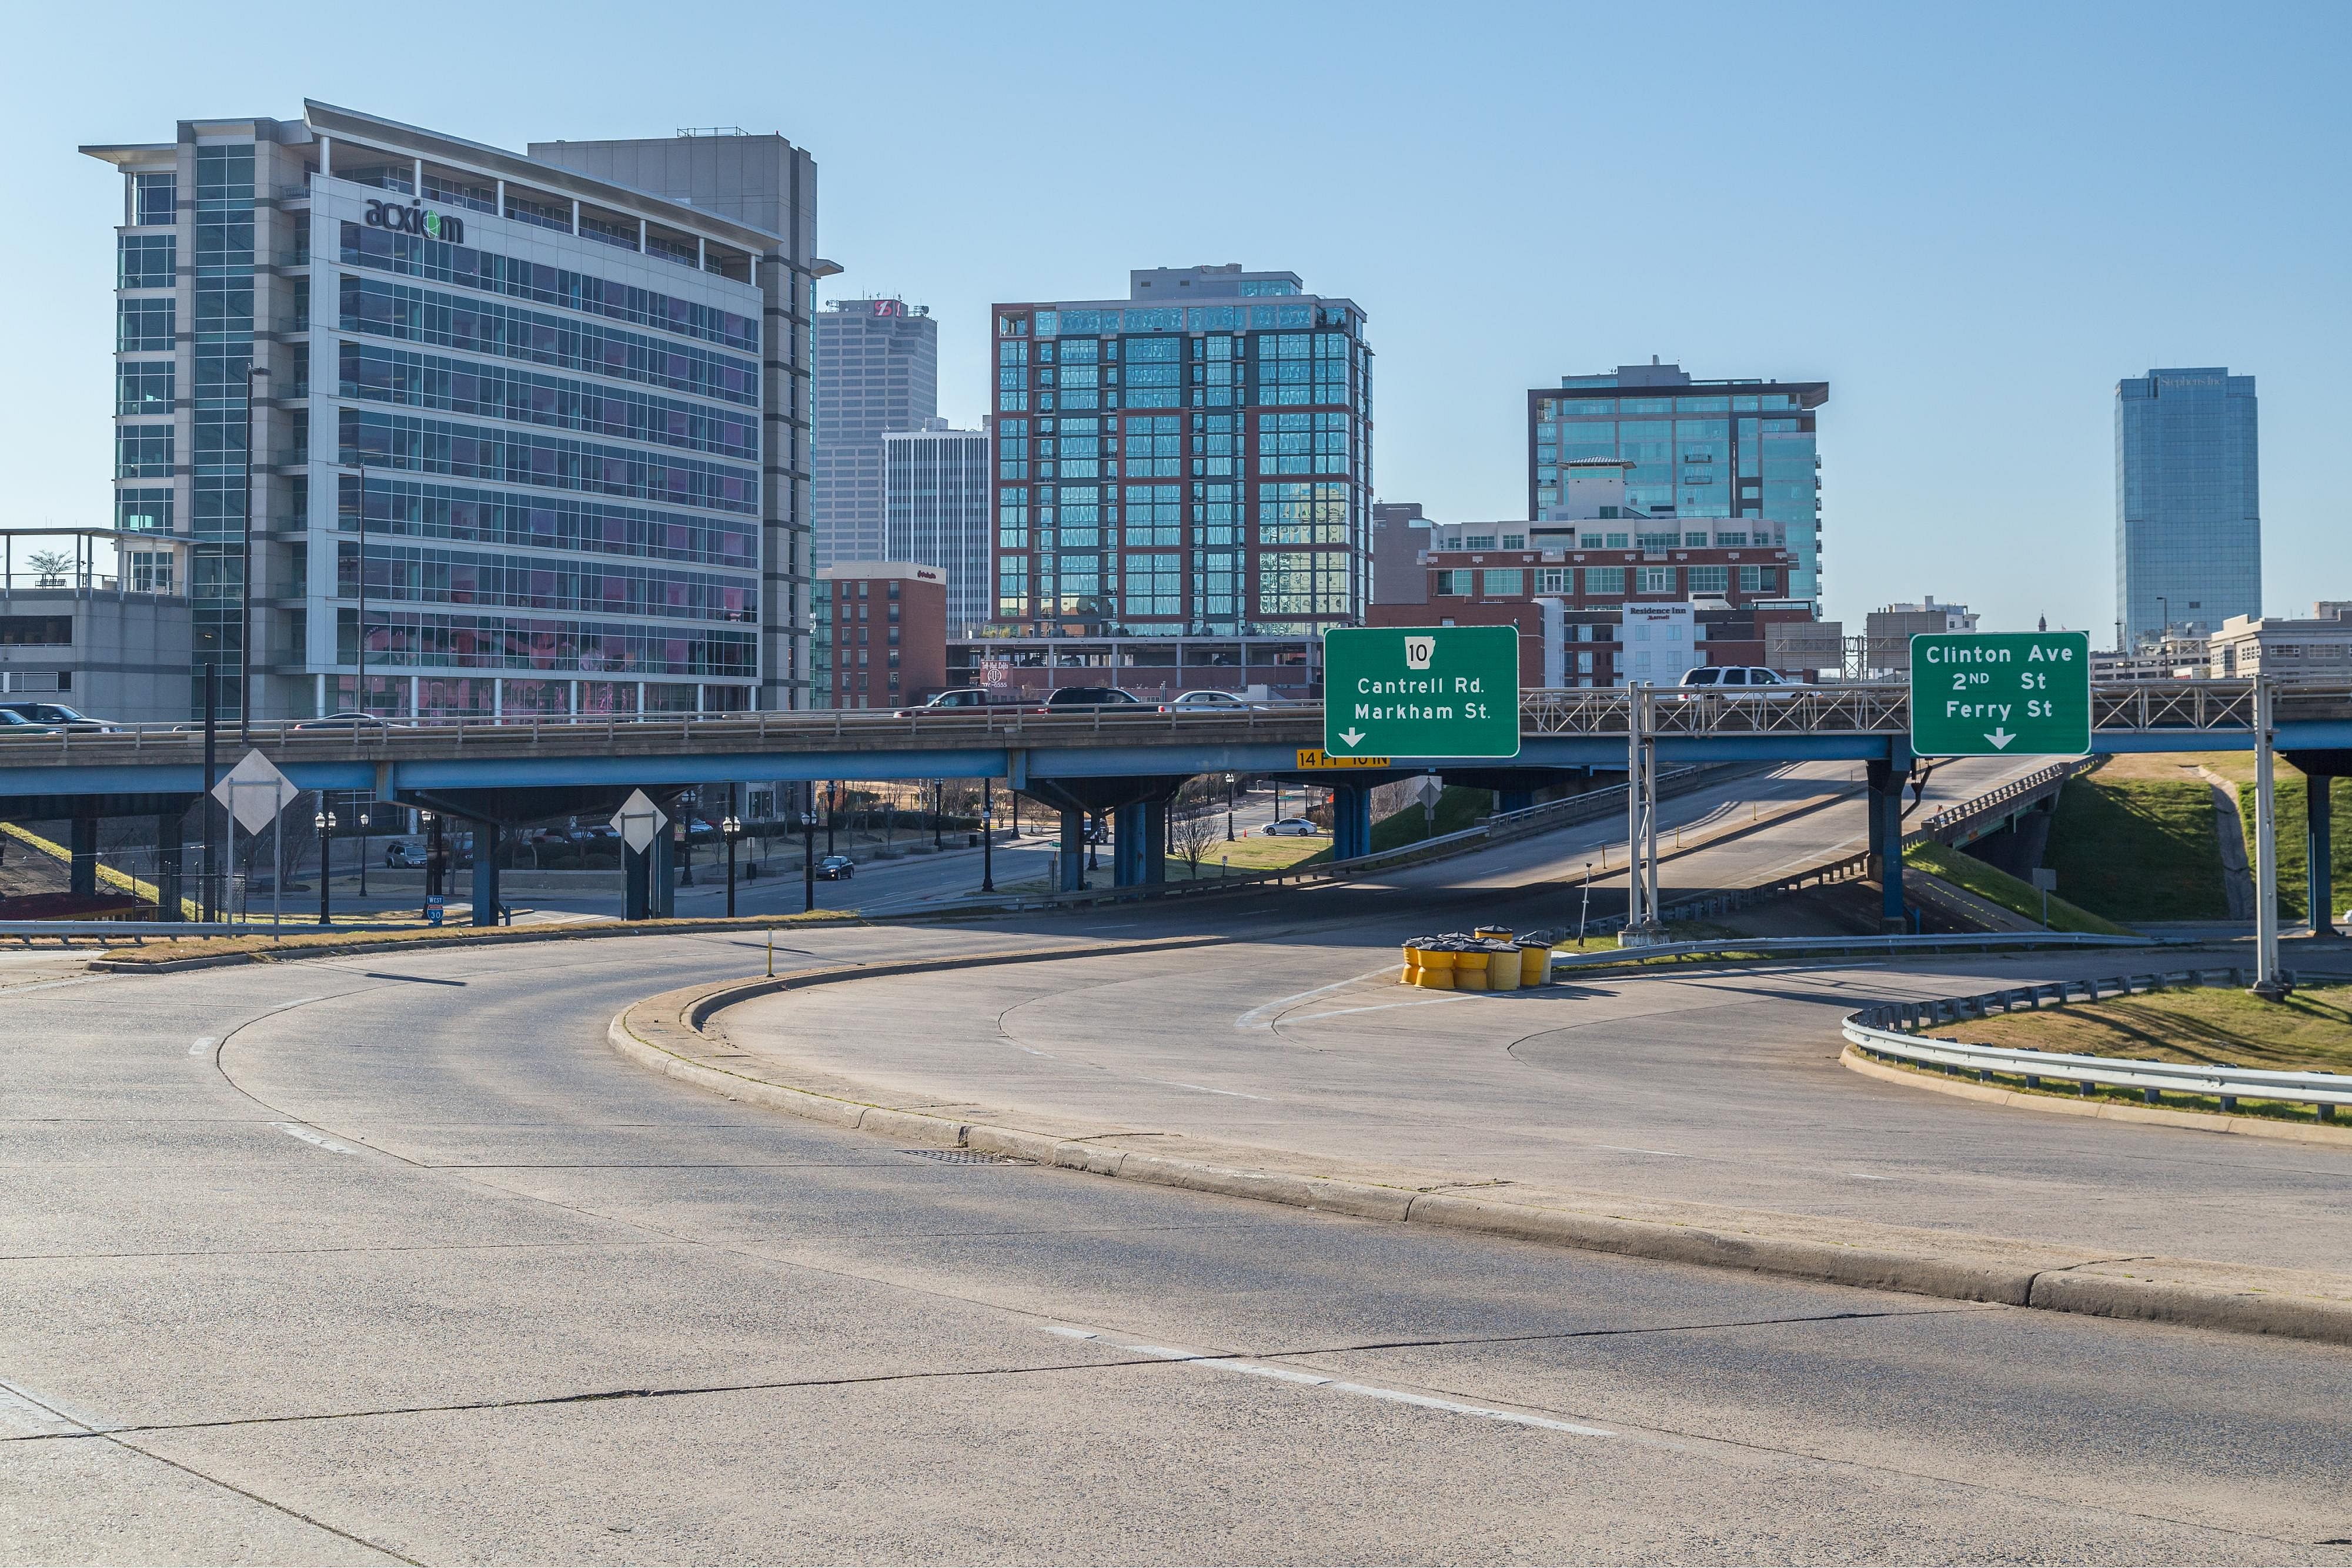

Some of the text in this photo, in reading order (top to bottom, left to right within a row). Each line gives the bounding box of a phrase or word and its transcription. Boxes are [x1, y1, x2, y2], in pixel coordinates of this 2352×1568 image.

[366, 199, 464, 244] acxiom
[2162, 376, 2206, 389] Stephens
[1409, 644, 1428, 662] 10
[1926, 644, 2073, 663] Clinton Ave
[1358, 677, 1485, 694] Cantrell Rd.
[1952, 673, 2046, 690] 2ND St
[1355, 702, 1491, 720] Markham St.
[1947, 700, 2052, 722] Ferry St
[1299, 752, 1316, 766] 14
